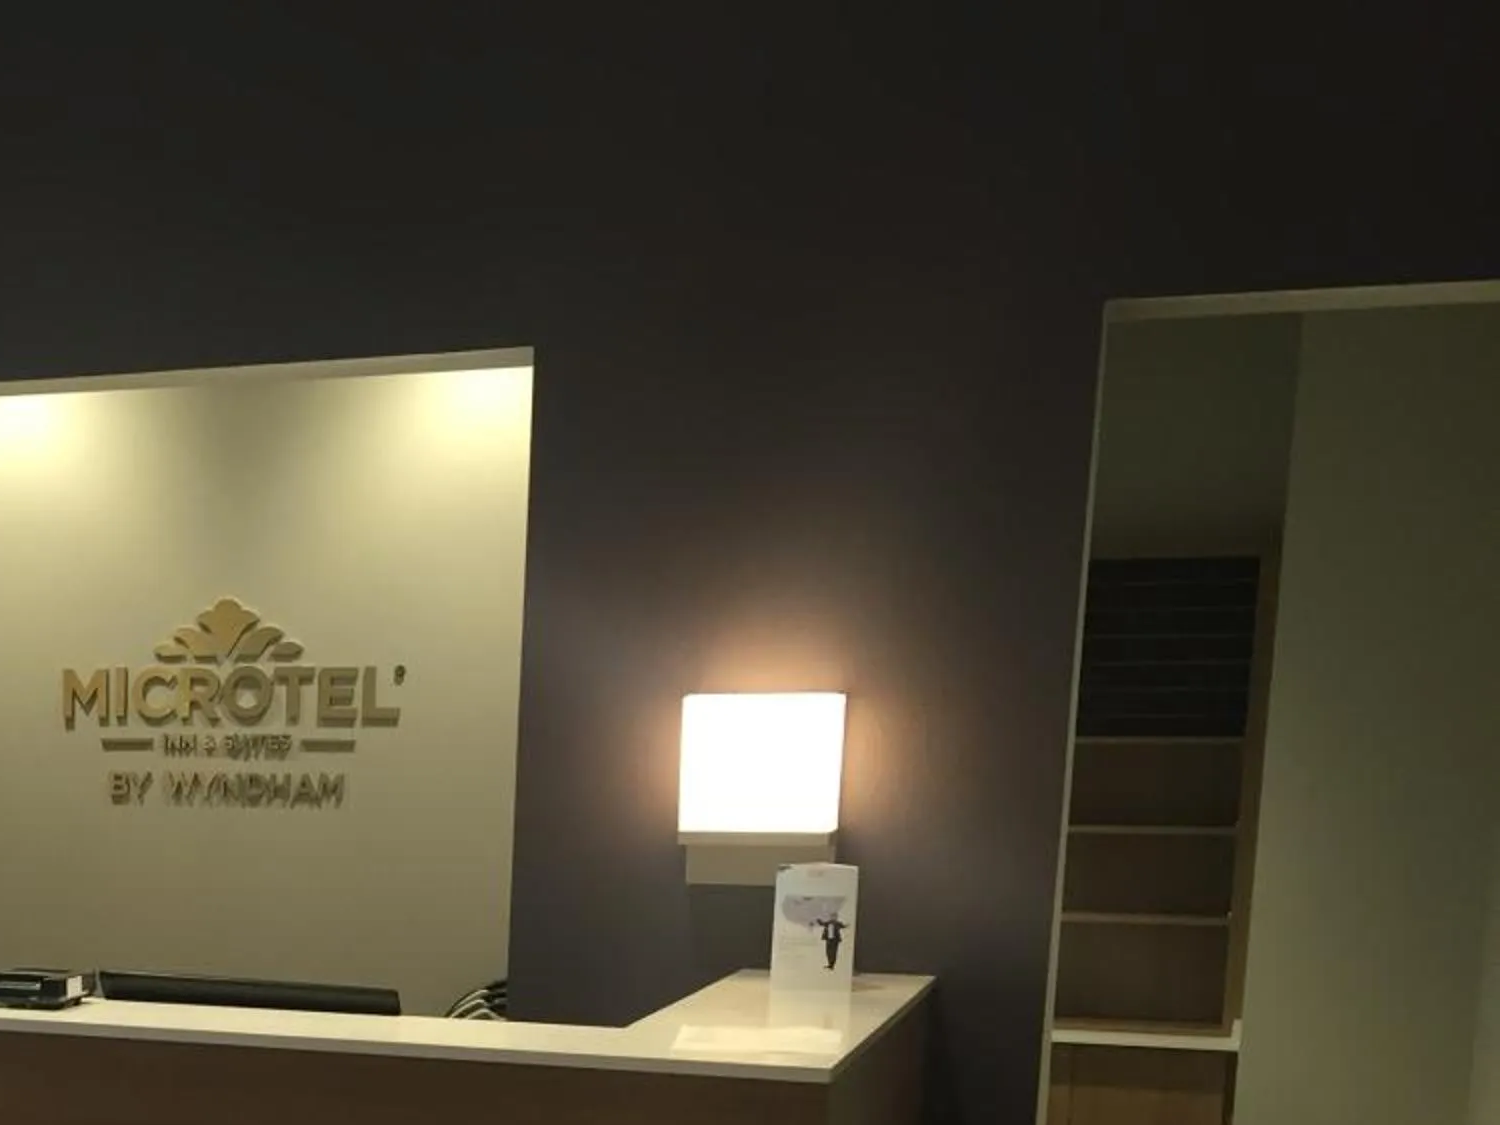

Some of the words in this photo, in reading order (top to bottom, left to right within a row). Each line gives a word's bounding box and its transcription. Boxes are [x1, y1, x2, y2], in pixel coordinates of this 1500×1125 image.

[62, 665, 400, 731] MICROTEL
[163, 734, 197, 757] INN
[110, 772, 153, 806] BY
[163, 772, 346, 808] WYNDHAM
